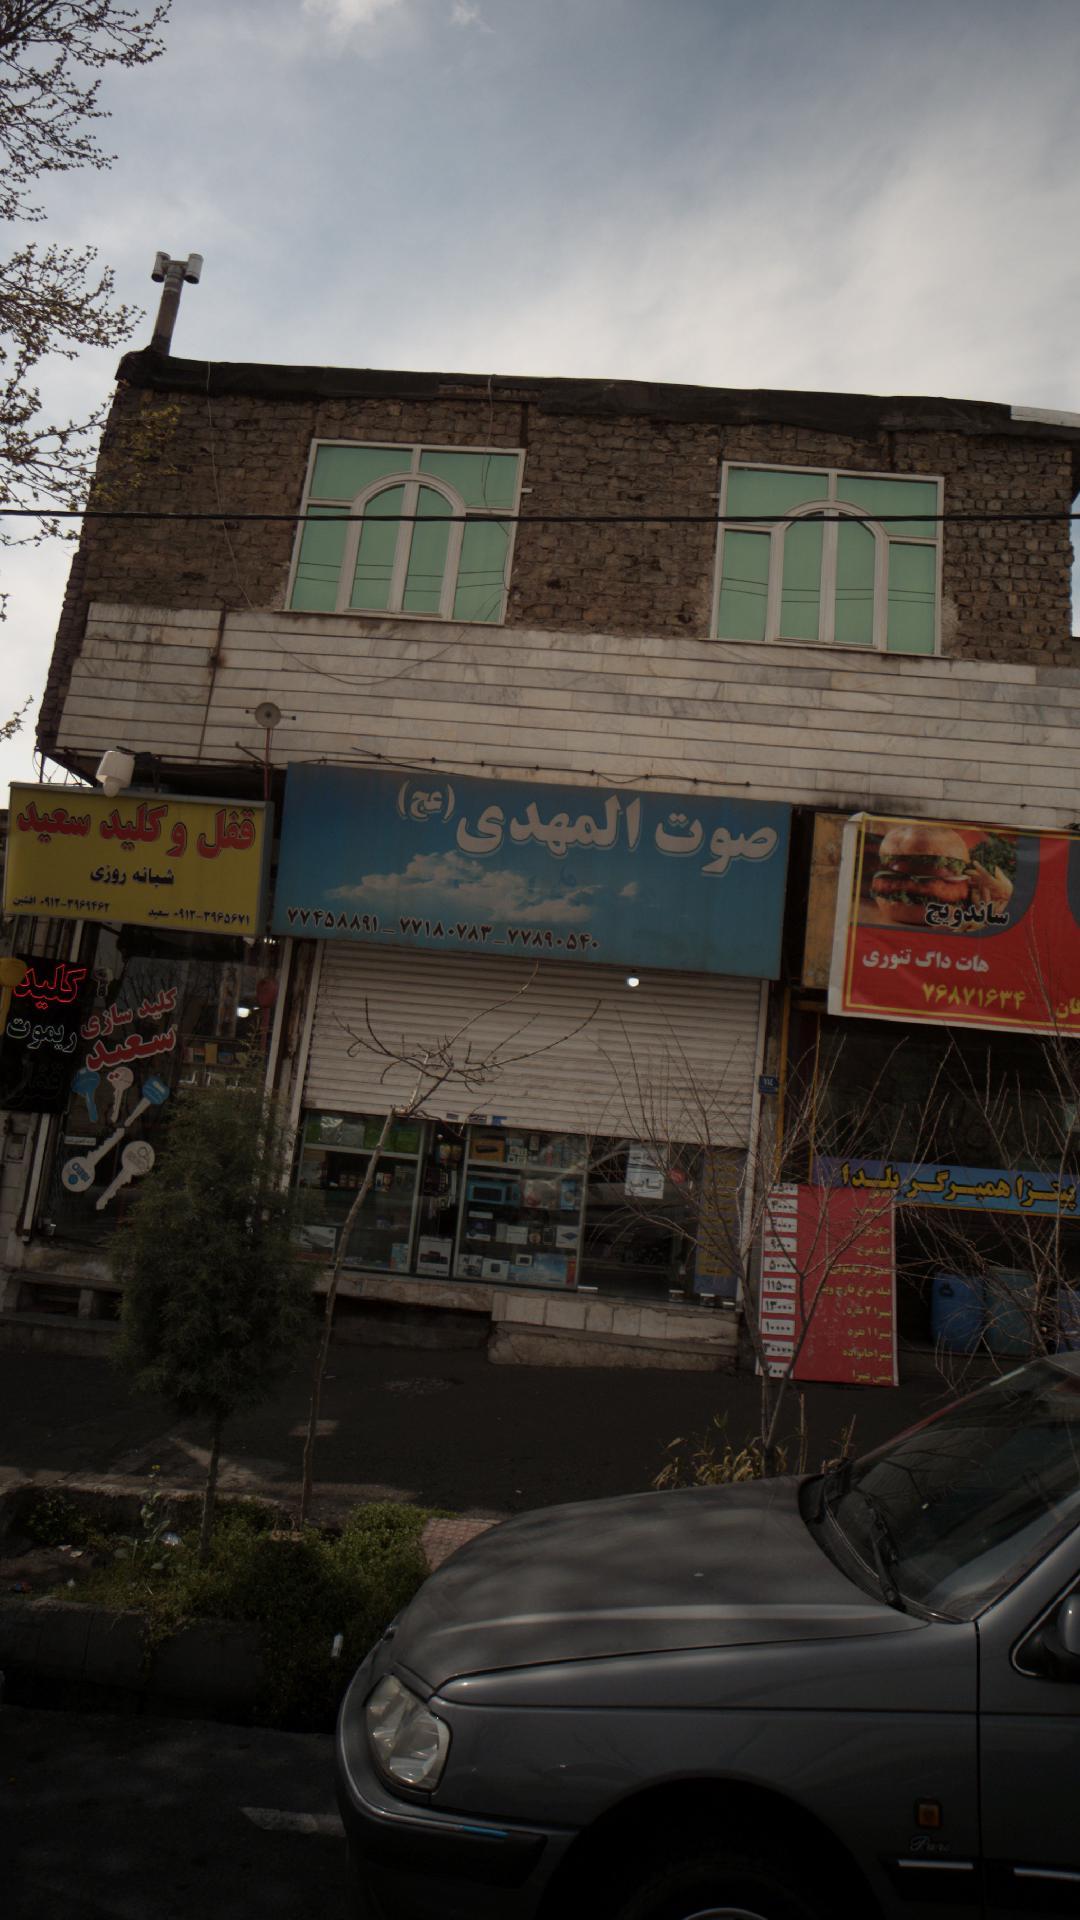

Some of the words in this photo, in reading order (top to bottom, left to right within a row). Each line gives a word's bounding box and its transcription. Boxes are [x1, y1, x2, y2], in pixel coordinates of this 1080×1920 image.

[398, 779, 455, 823] (عج)
[17, 802, 91, 844] سعید
[100, 802, 168, 851] کلید
[166, 820, 188, 858] و
[197, 807, 256, 859] قفل
[456, 794, 642, 858] المهدی
[655, 811, 778, 876] صوت
[90, 864, 127, 885] روزی
[133, 866, 175, 886] شبانه
[925, 902, 1010, 927] ساندویچ
[862, 949, 913, 970] تنوری
[914, 950, 951, 970] داگ
[955, 952, 989, 972] هات
[13, 963, 88, 1011] کلید
[137, 986, 178, 1022] کلید
[922, 982, 1027, 1011] ۷۶۸۷۱۶۳۴
[6, 1016, 78, 1053] ریموت
[80, 1003, 134, 1039] سازی
[86, 1024, 177, 1071] سعید
